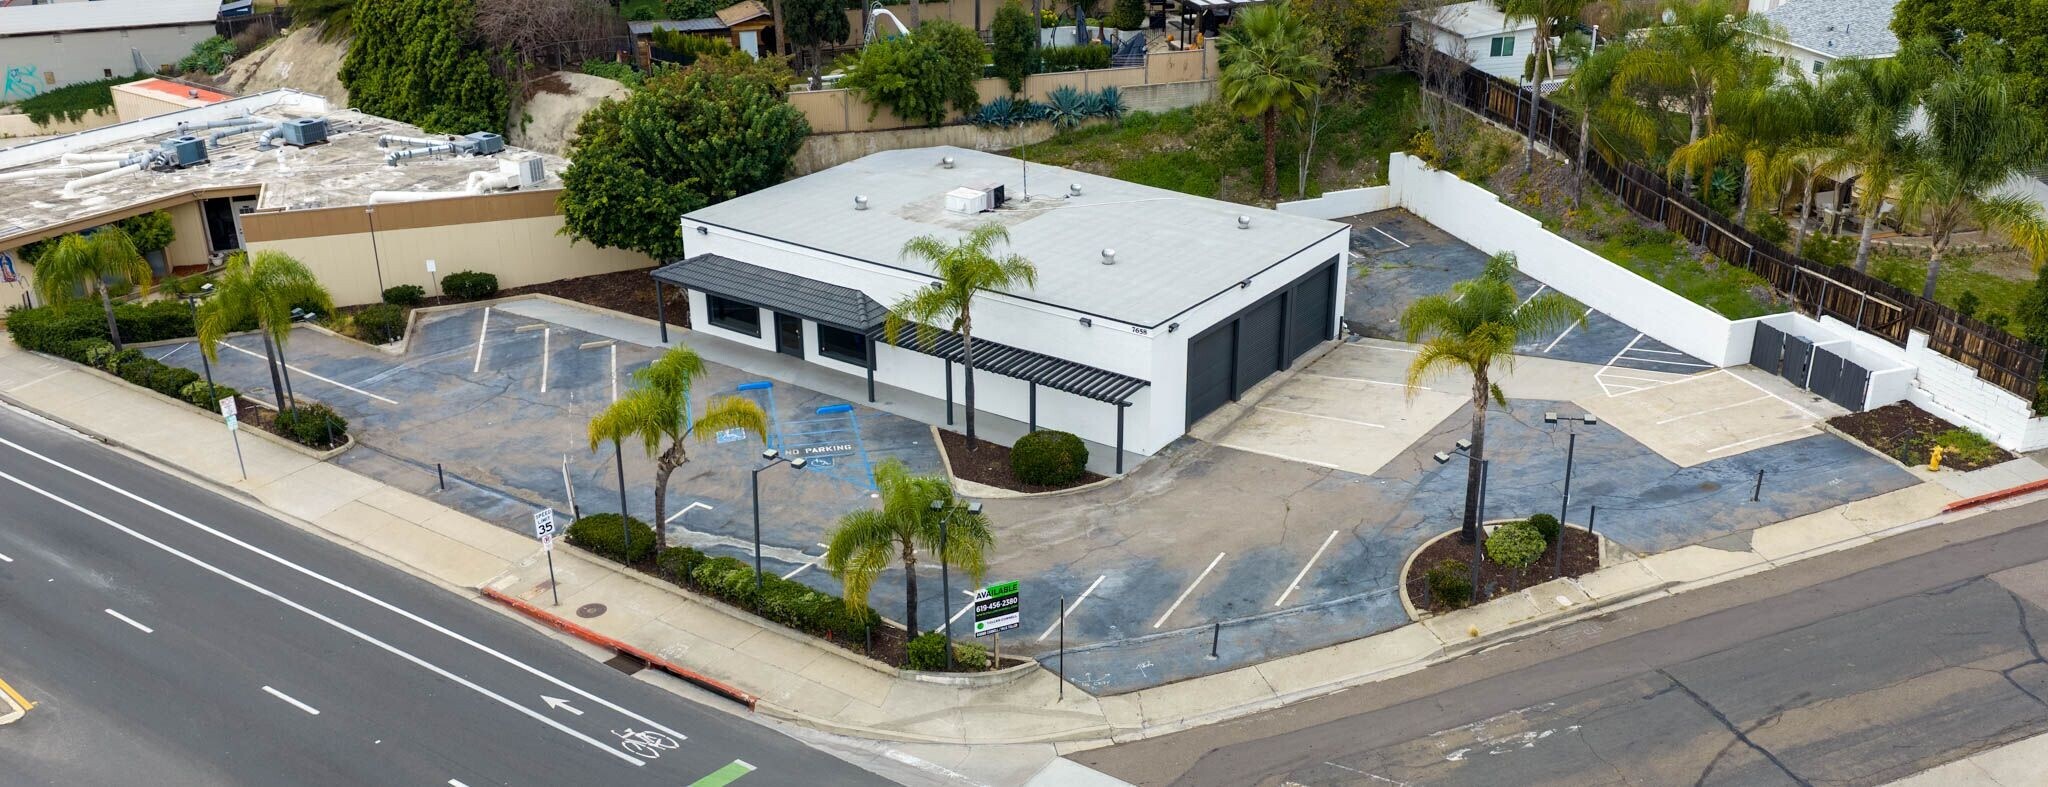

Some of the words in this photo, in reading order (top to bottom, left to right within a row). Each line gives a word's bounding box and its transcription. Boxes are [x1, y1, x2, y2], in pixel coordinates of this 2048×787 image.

[805, 444, 852, 454] PARKING
[535, 509, 552, 519] SPEED
[538, 521, 553, 535] 35
[976, 583, 1018, 600] AVAILABLE
